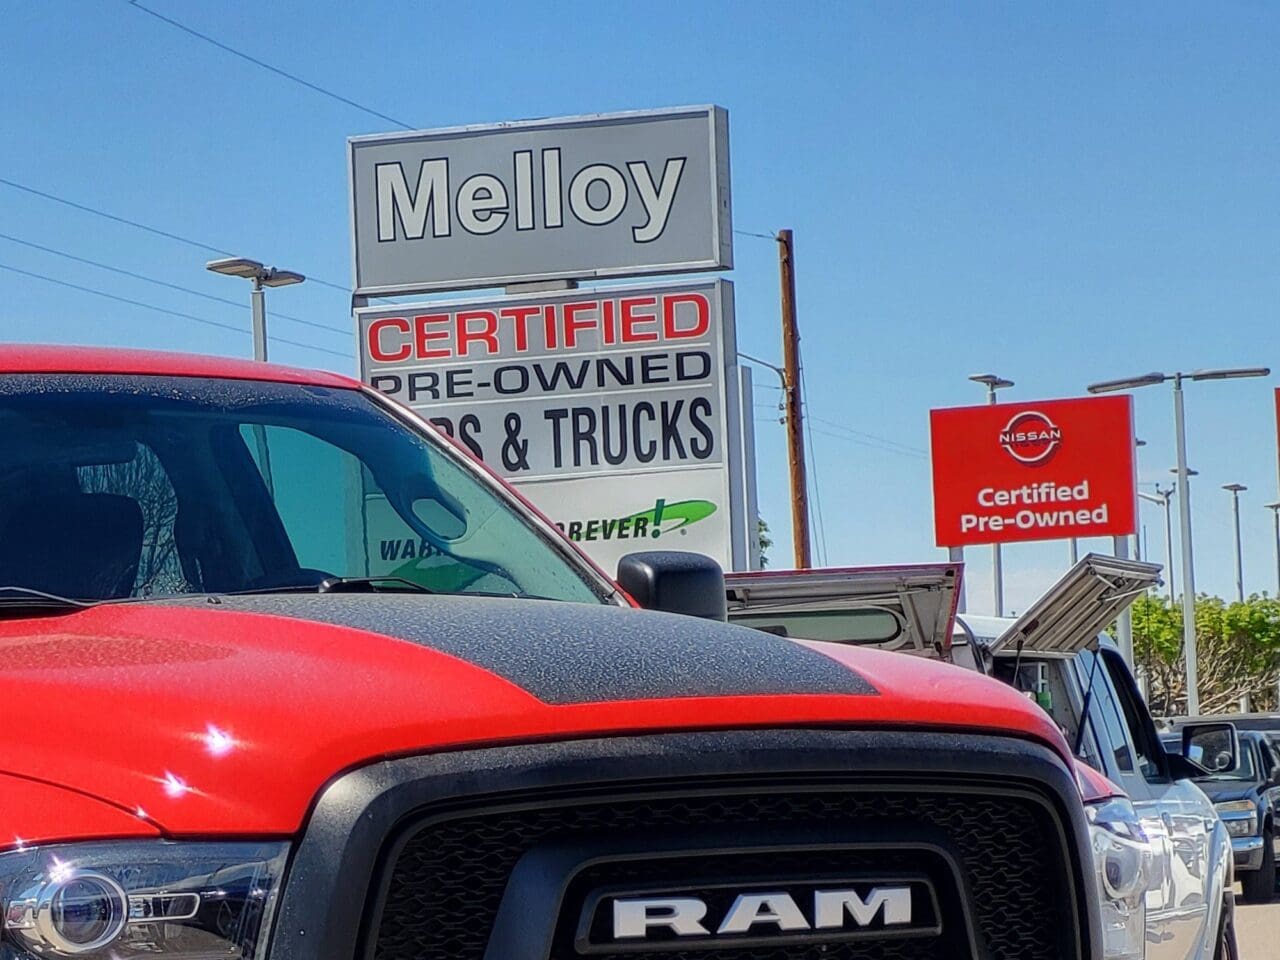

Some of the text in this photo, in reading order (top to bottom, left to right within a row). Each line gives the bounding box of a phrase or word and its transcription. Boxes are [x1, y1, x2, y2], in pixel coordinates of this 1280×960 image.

[374, 147, 688, 243] Melloy
[367, 293, 711, 362] CERTIFIED
[370, 350, 712, 401] PRE-OWNED
[501, 411, 530, 472] &
[544, 397, 714, 469] TRUCKS
[999, 428, 1061, 443] NISSAN
[960, 504, 1108, 532] Pre-Owned
[977, 480, 1089, 507] Certified
[613, 886, 912, 939] RAM
